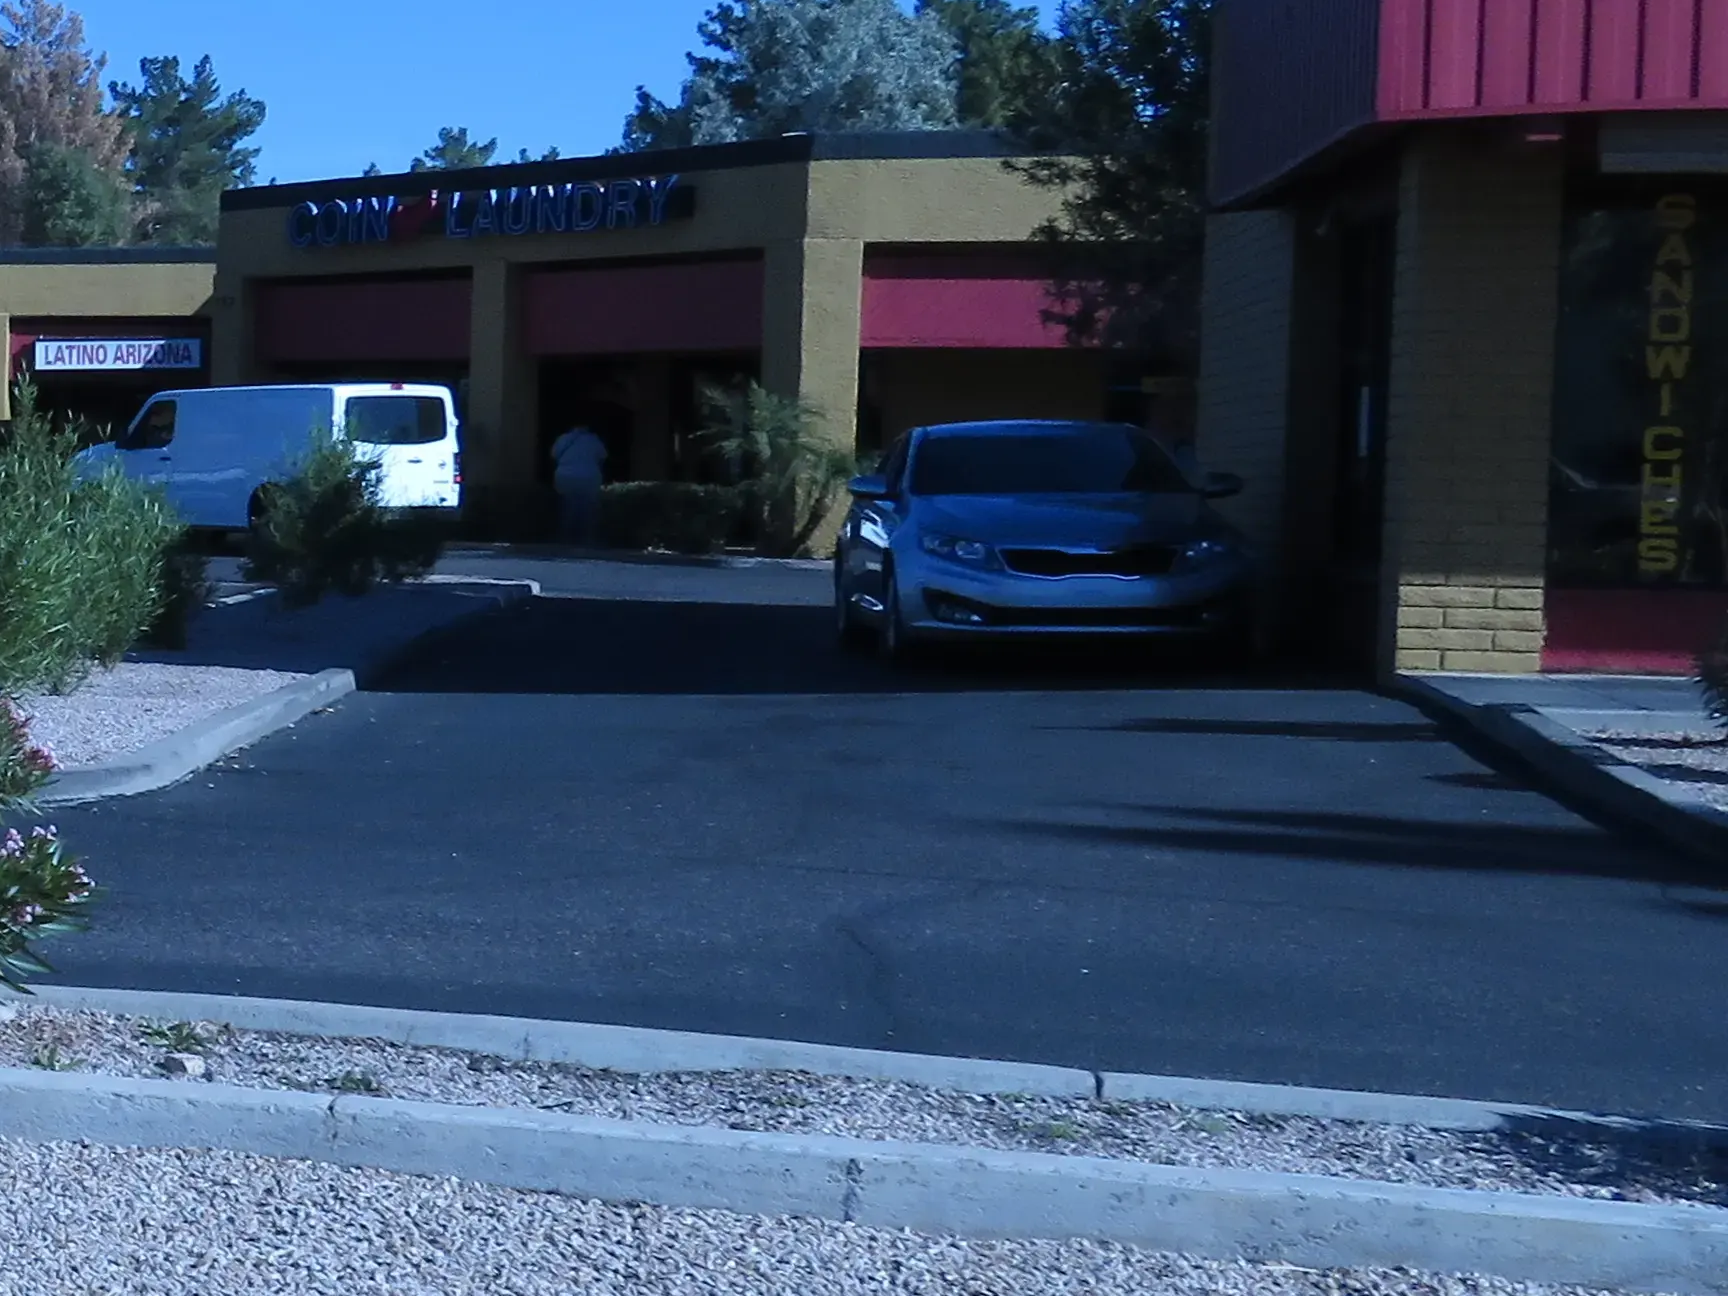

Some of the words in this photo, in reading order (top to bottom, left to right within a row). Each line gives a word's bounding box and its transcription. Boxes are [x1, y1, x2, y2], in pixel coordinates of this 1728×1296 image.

[287, 195, 396, 249] COIN
[445, 175, 680, 239] LAUNDRY
[45, 343, 107, 365] LATINO
[112, 343, 192, 365] ARIZONA
[1636, 193, 1697, 574] SANDWICHES
